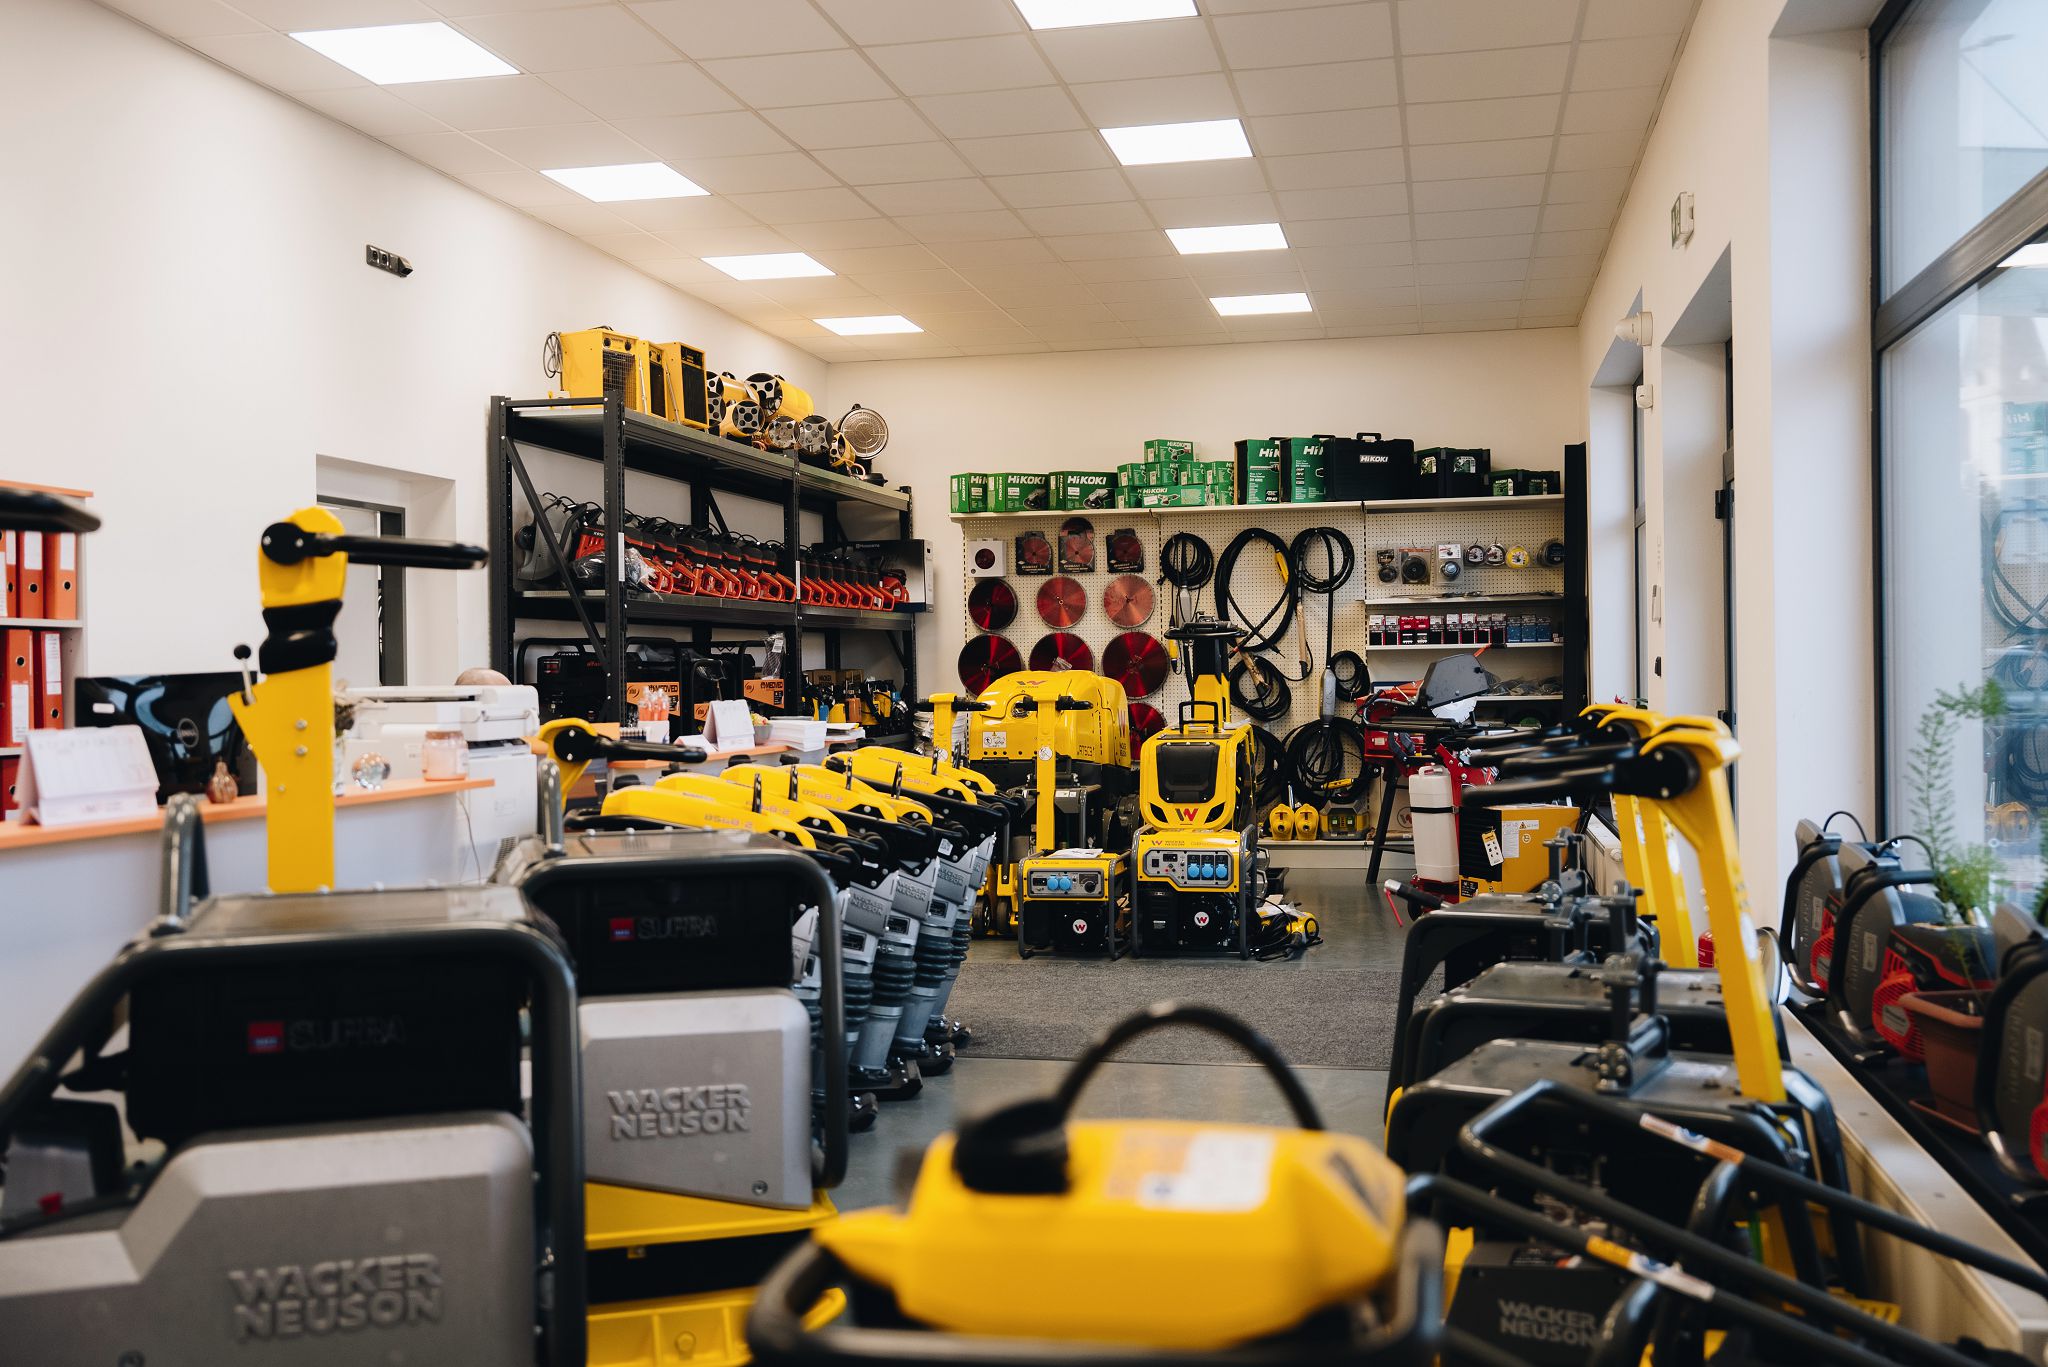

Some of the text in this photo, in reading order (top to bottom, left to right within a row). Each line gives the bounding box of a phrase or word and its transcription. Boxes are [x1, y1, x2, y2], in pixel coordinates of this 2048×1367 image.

[1007, 475, 1046, 484] HiKOKI
[1067, 475, 1107, 485] HiKOKI
[608, 1083, 752, 1114] WACKER
[611, 1108, 751, 1141] NEUSON
[228, 1253, 444, 1301] WACKER
[232, 1287, 445, 1343] NEUSON
[1498, 1299, 1597, 1330] WACKER
[1500, 1316, 1598, 1347] NEUSON
